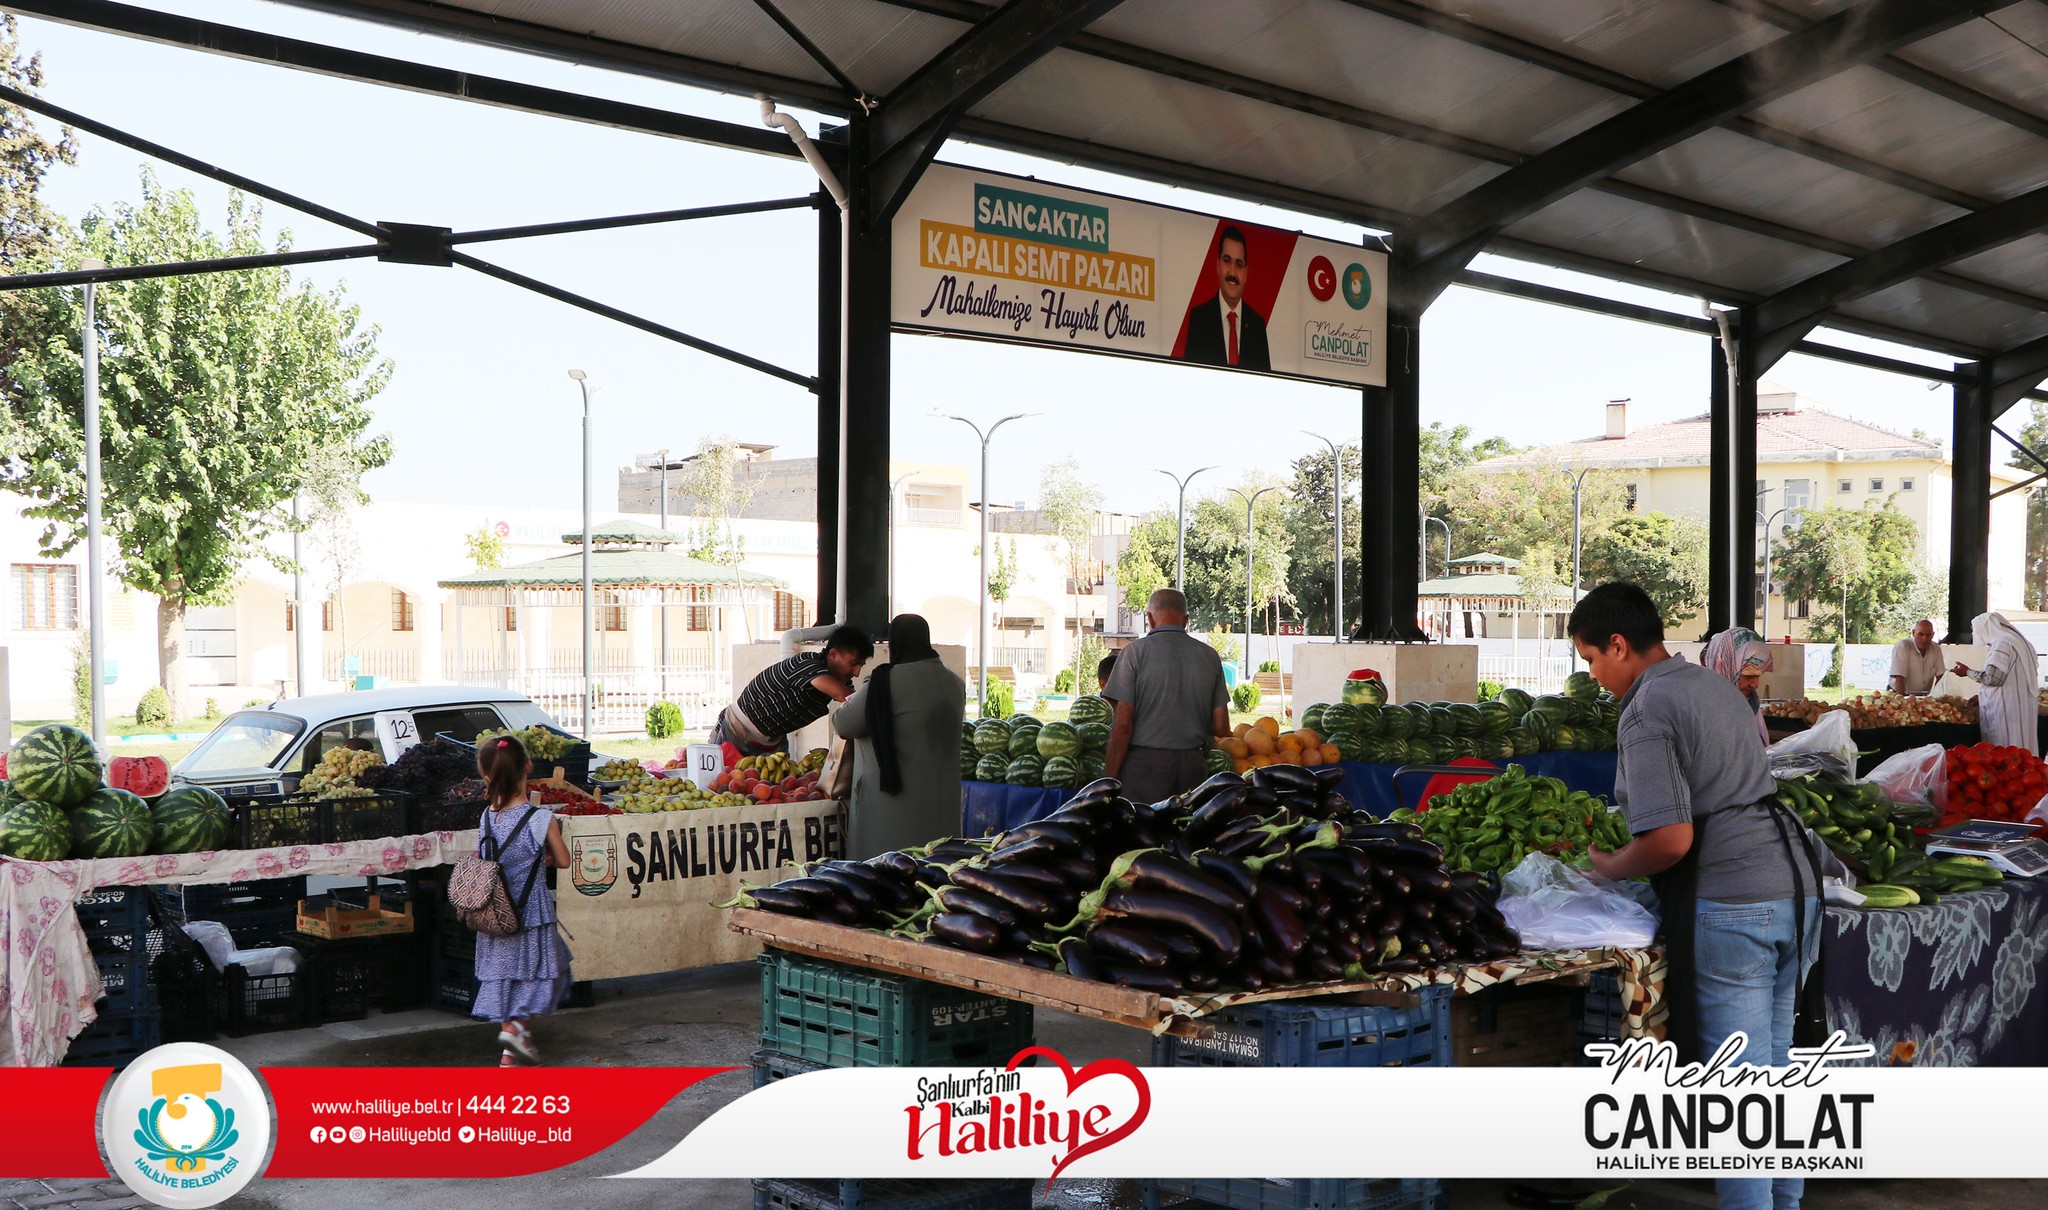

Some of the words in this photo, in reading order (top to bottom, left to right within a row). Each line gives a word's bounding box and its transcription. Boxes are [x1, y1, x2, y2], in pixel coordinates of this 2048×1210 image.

[977, 195, 1106, 245] SANCAKTAR
[926, 229, 1010, 275] KAPALI
[1014, 243, 1071, 284] SEMT
[1075, 254, 1149, 297] PAZARI
[920, 274, 1032, 332] Mahallemize
[1040, 288, 1100, 339] Hayırlı
[1104, 300, 1146, 340] Olsun
[1313, 320, 1368, 340] Mehmet
[1312, 334, 1369, 357] CANPOLAT
[626, 819, 795, 899] ŞANLIURFA
[932, 1006, 1008, 1027] STAR
[1229, 1042, 1259, 1058] OSMAN
[1230, 1033, 1259, 1047] NO:117
